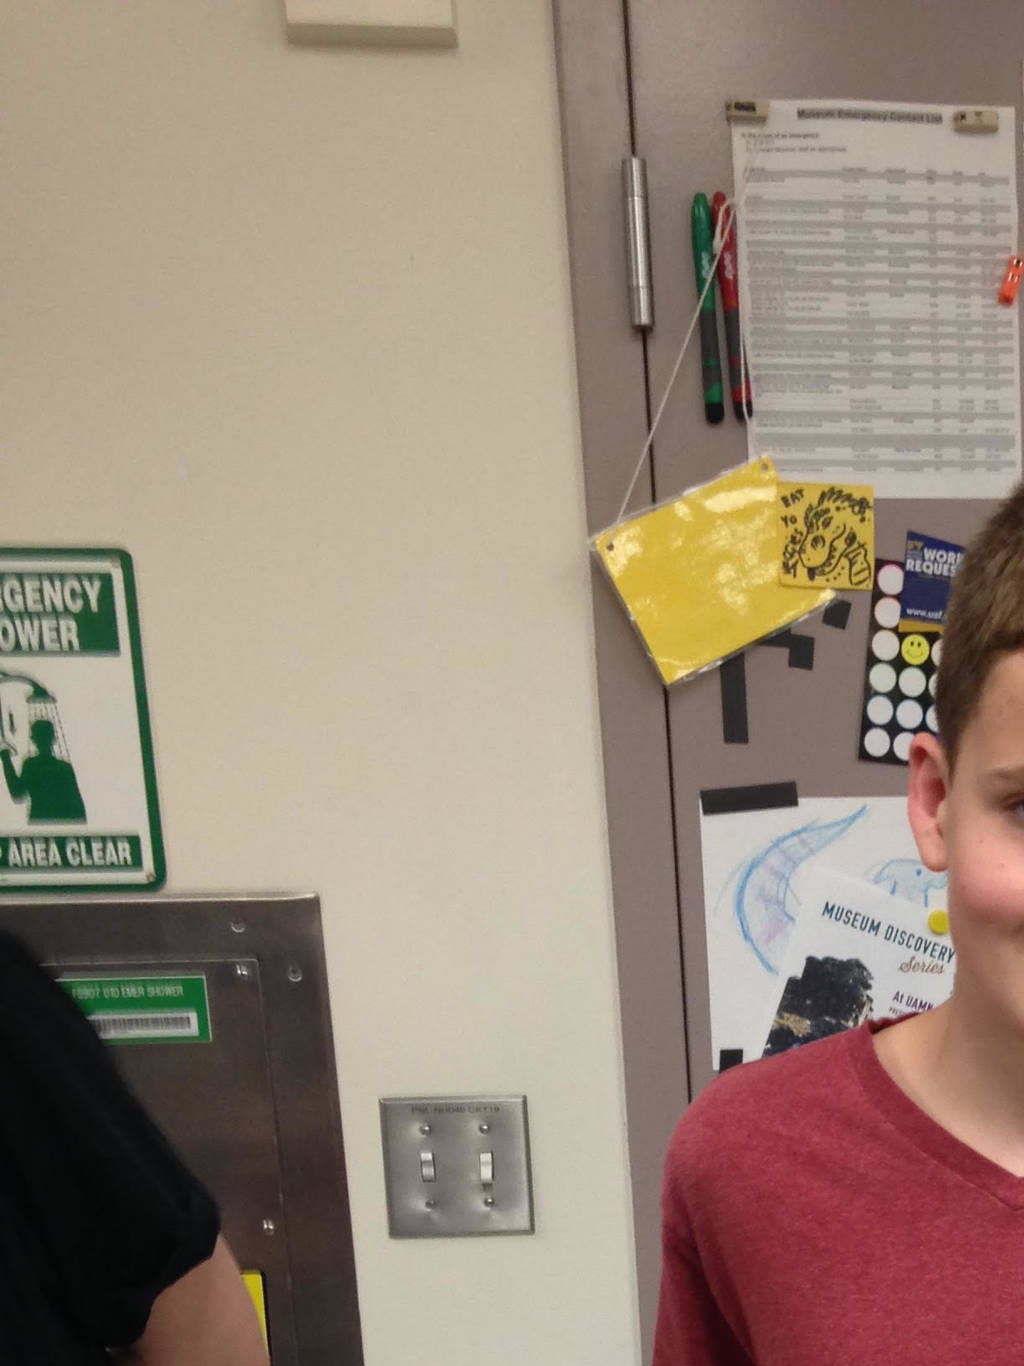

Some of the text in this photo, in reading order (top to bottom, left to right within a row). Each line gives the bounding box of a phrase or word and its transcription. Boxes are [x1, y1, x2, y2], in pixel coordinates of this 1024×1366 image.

[906, 558, 959, 577] REQUES
[0, 576, 101, 614] GENCY
[8, 837, 62, 868] AREA
[66, 836, 132, 867] CLEAR
[822, 901, 956, 963] MUSEUM DISCOVERY
[899, 956, 945, 975] Series
